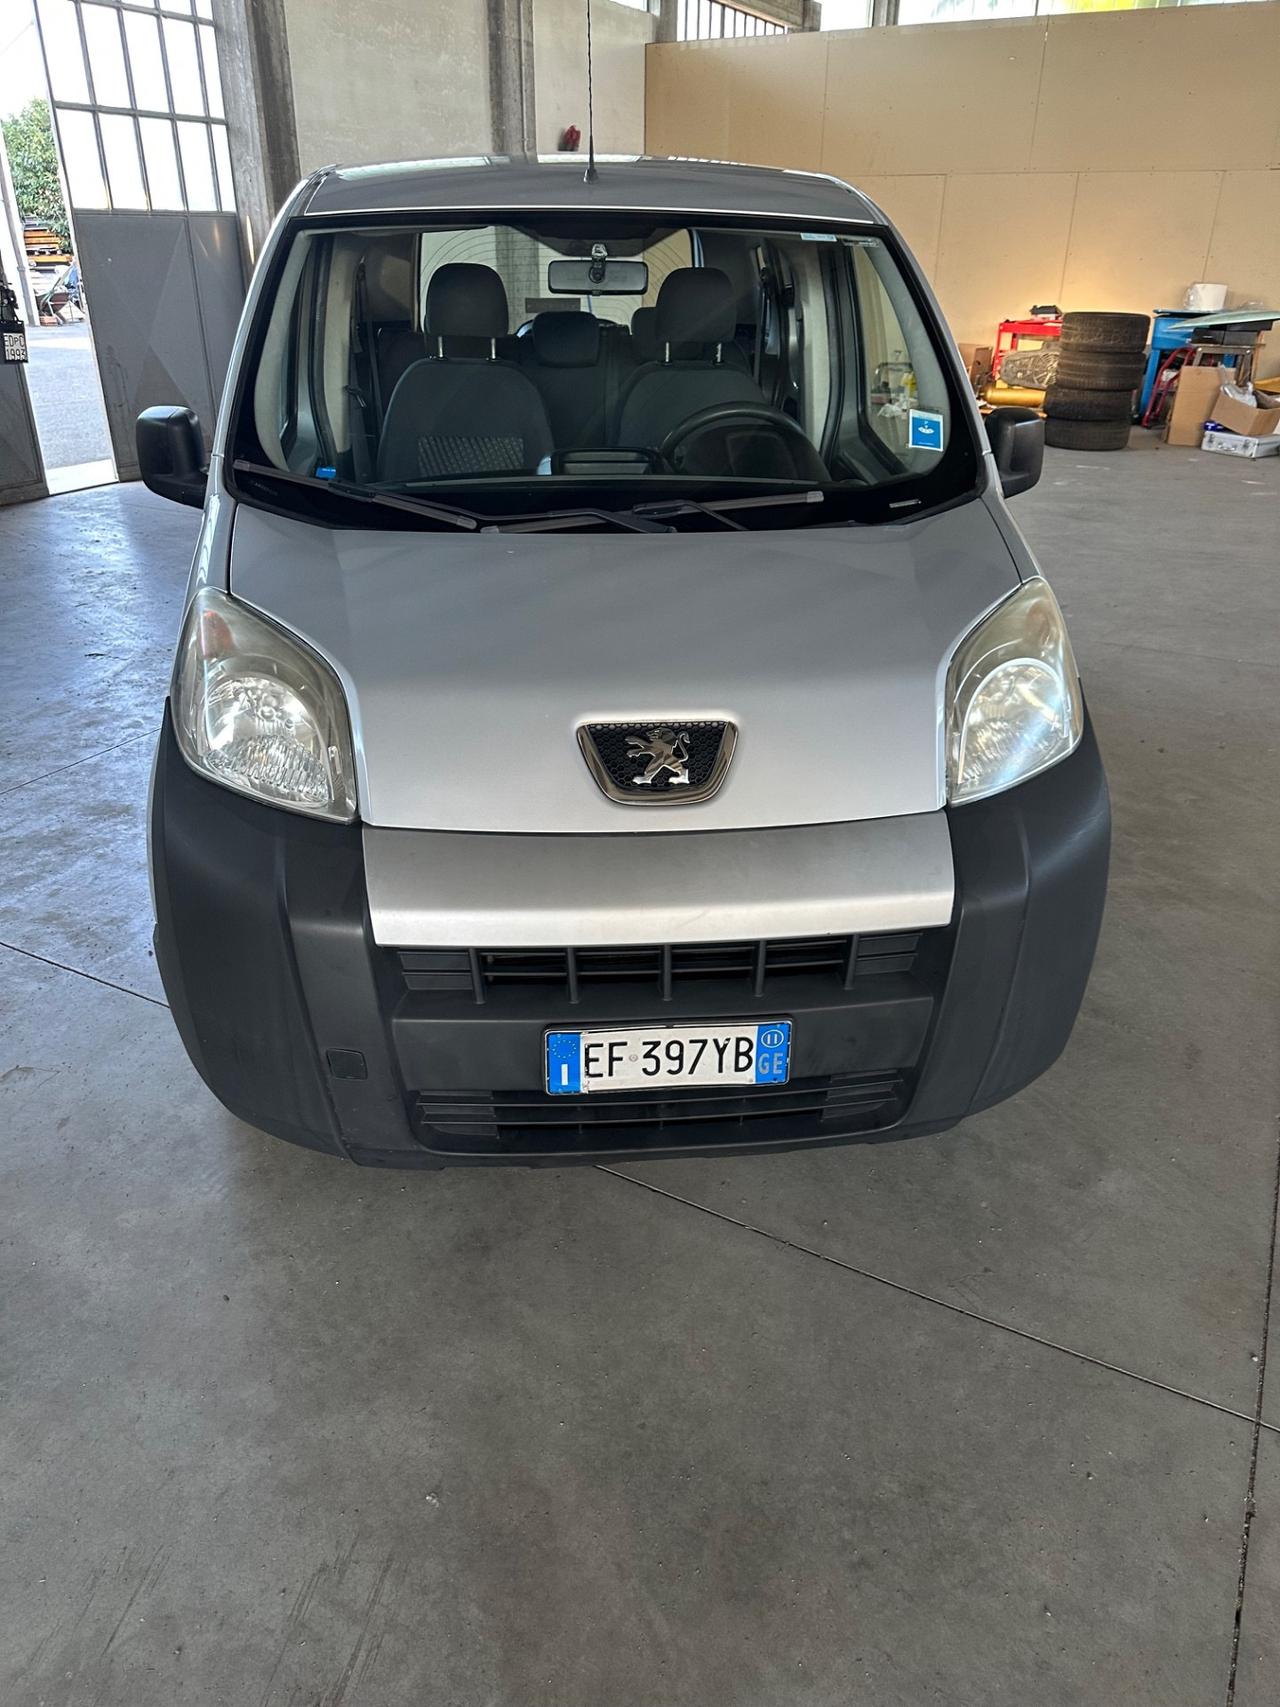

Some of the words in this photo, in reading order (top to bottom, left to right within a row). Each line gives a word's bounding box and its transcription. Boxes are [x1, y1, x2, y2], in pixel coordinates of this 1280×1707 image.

[585, 1041, 628, 1078] EF
[641, 1037, 754, 1077] 397YB
[758, 1052, 784, 1075] GE
